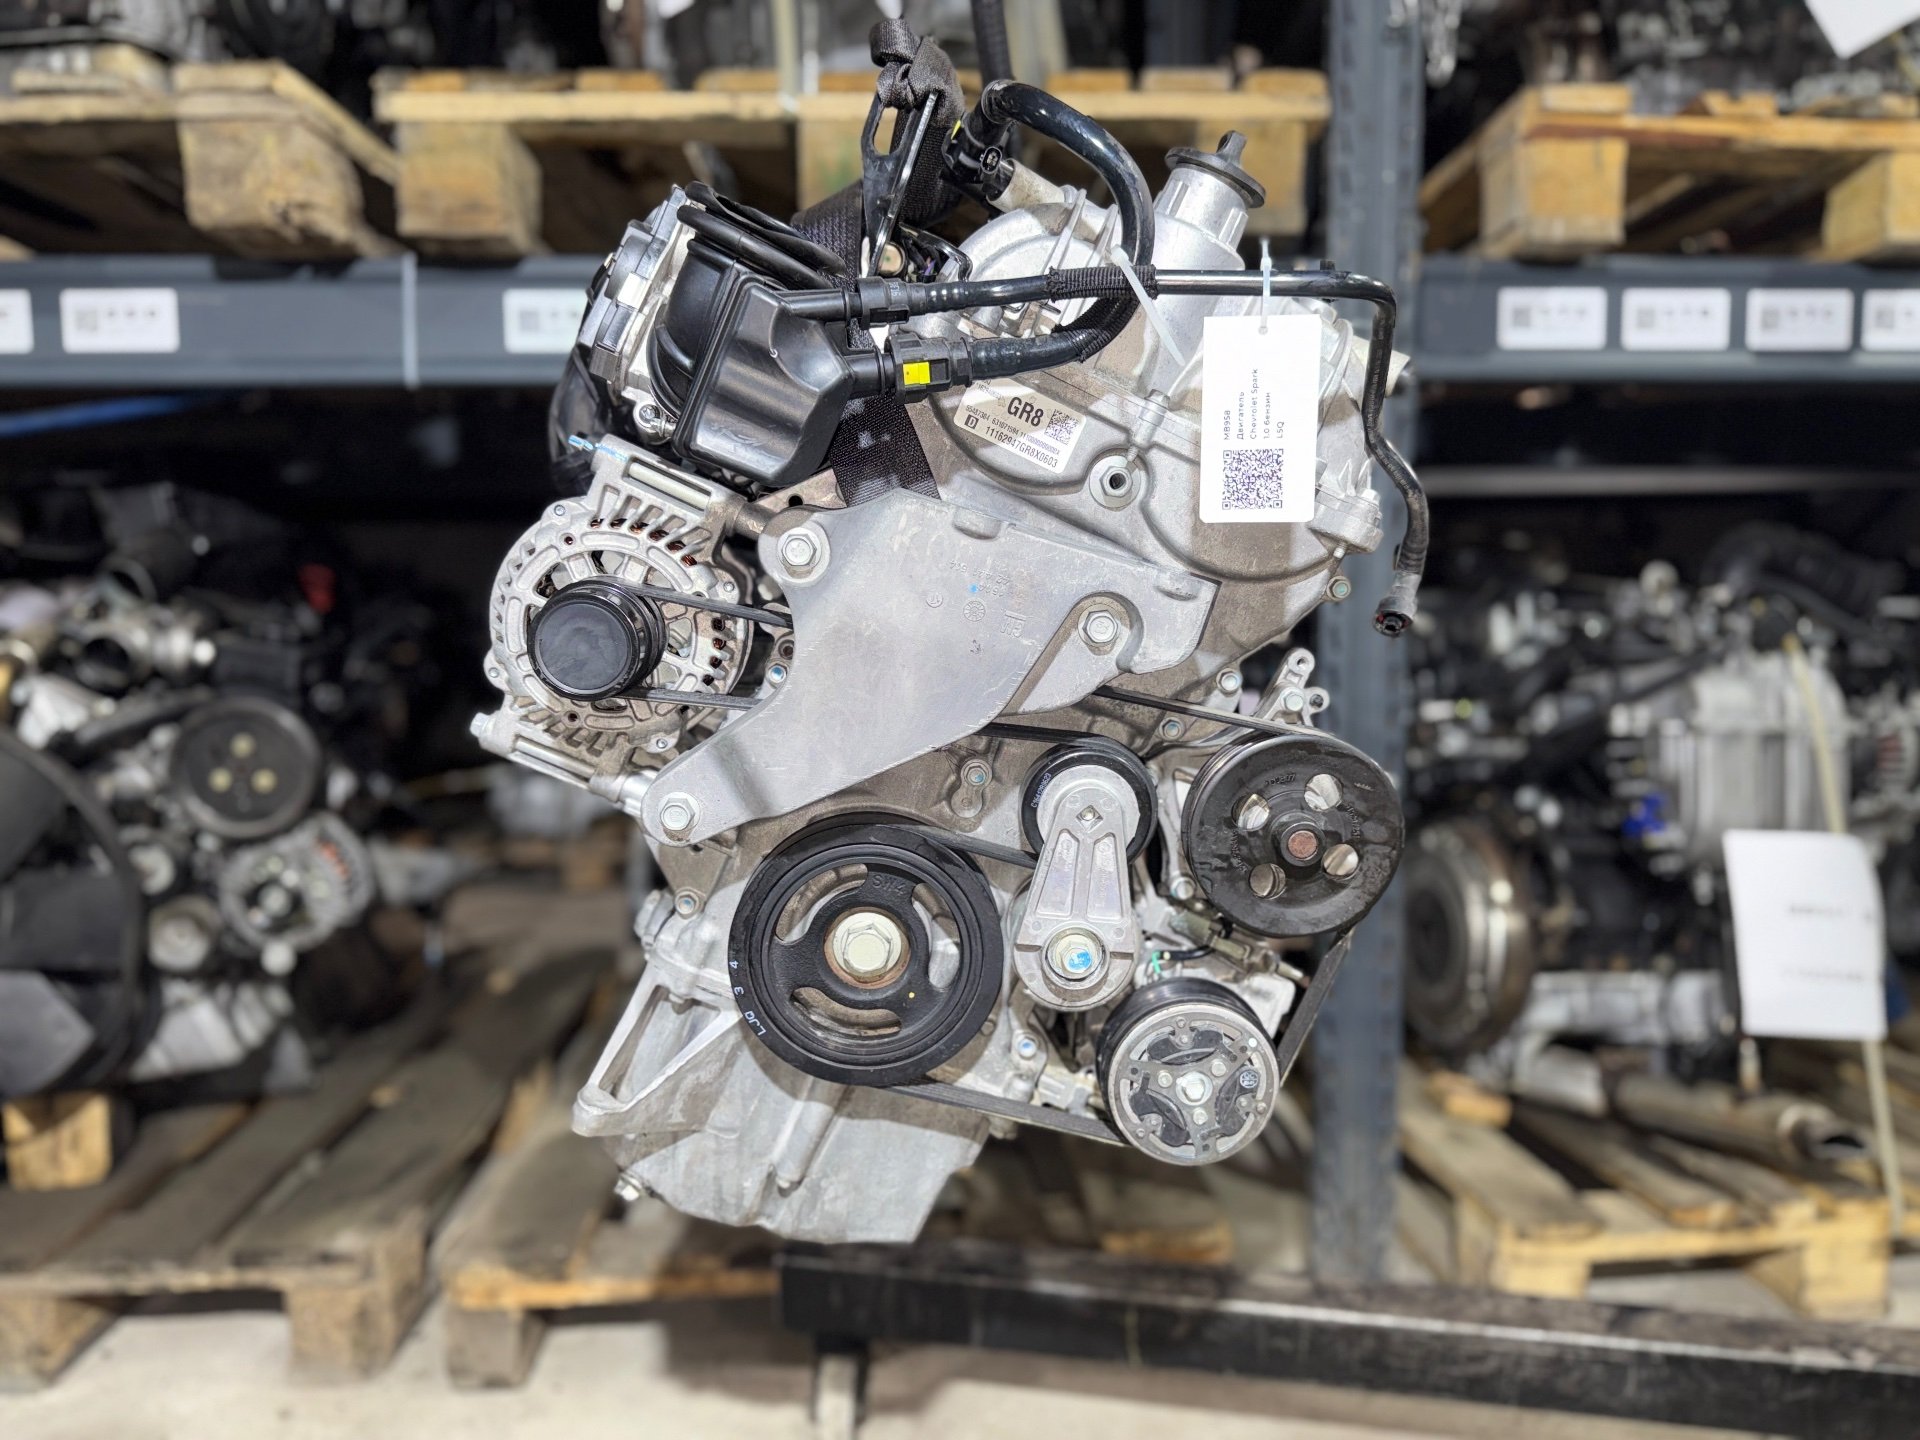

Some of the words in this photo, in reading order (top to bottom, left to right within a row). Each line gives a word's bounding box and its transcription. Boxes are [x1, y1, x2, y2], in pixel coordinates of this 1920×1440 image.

[1250, 368, 1260, 394] Spark
[1008, 396, 1044, 427] GR8
[1236, 392, 1244, 440] Двигатель
[1250, 396, 1258, 440] Chevrolet
[1263, 392, 1271, 426] бензин
[729, 960, 739, 969] 4
